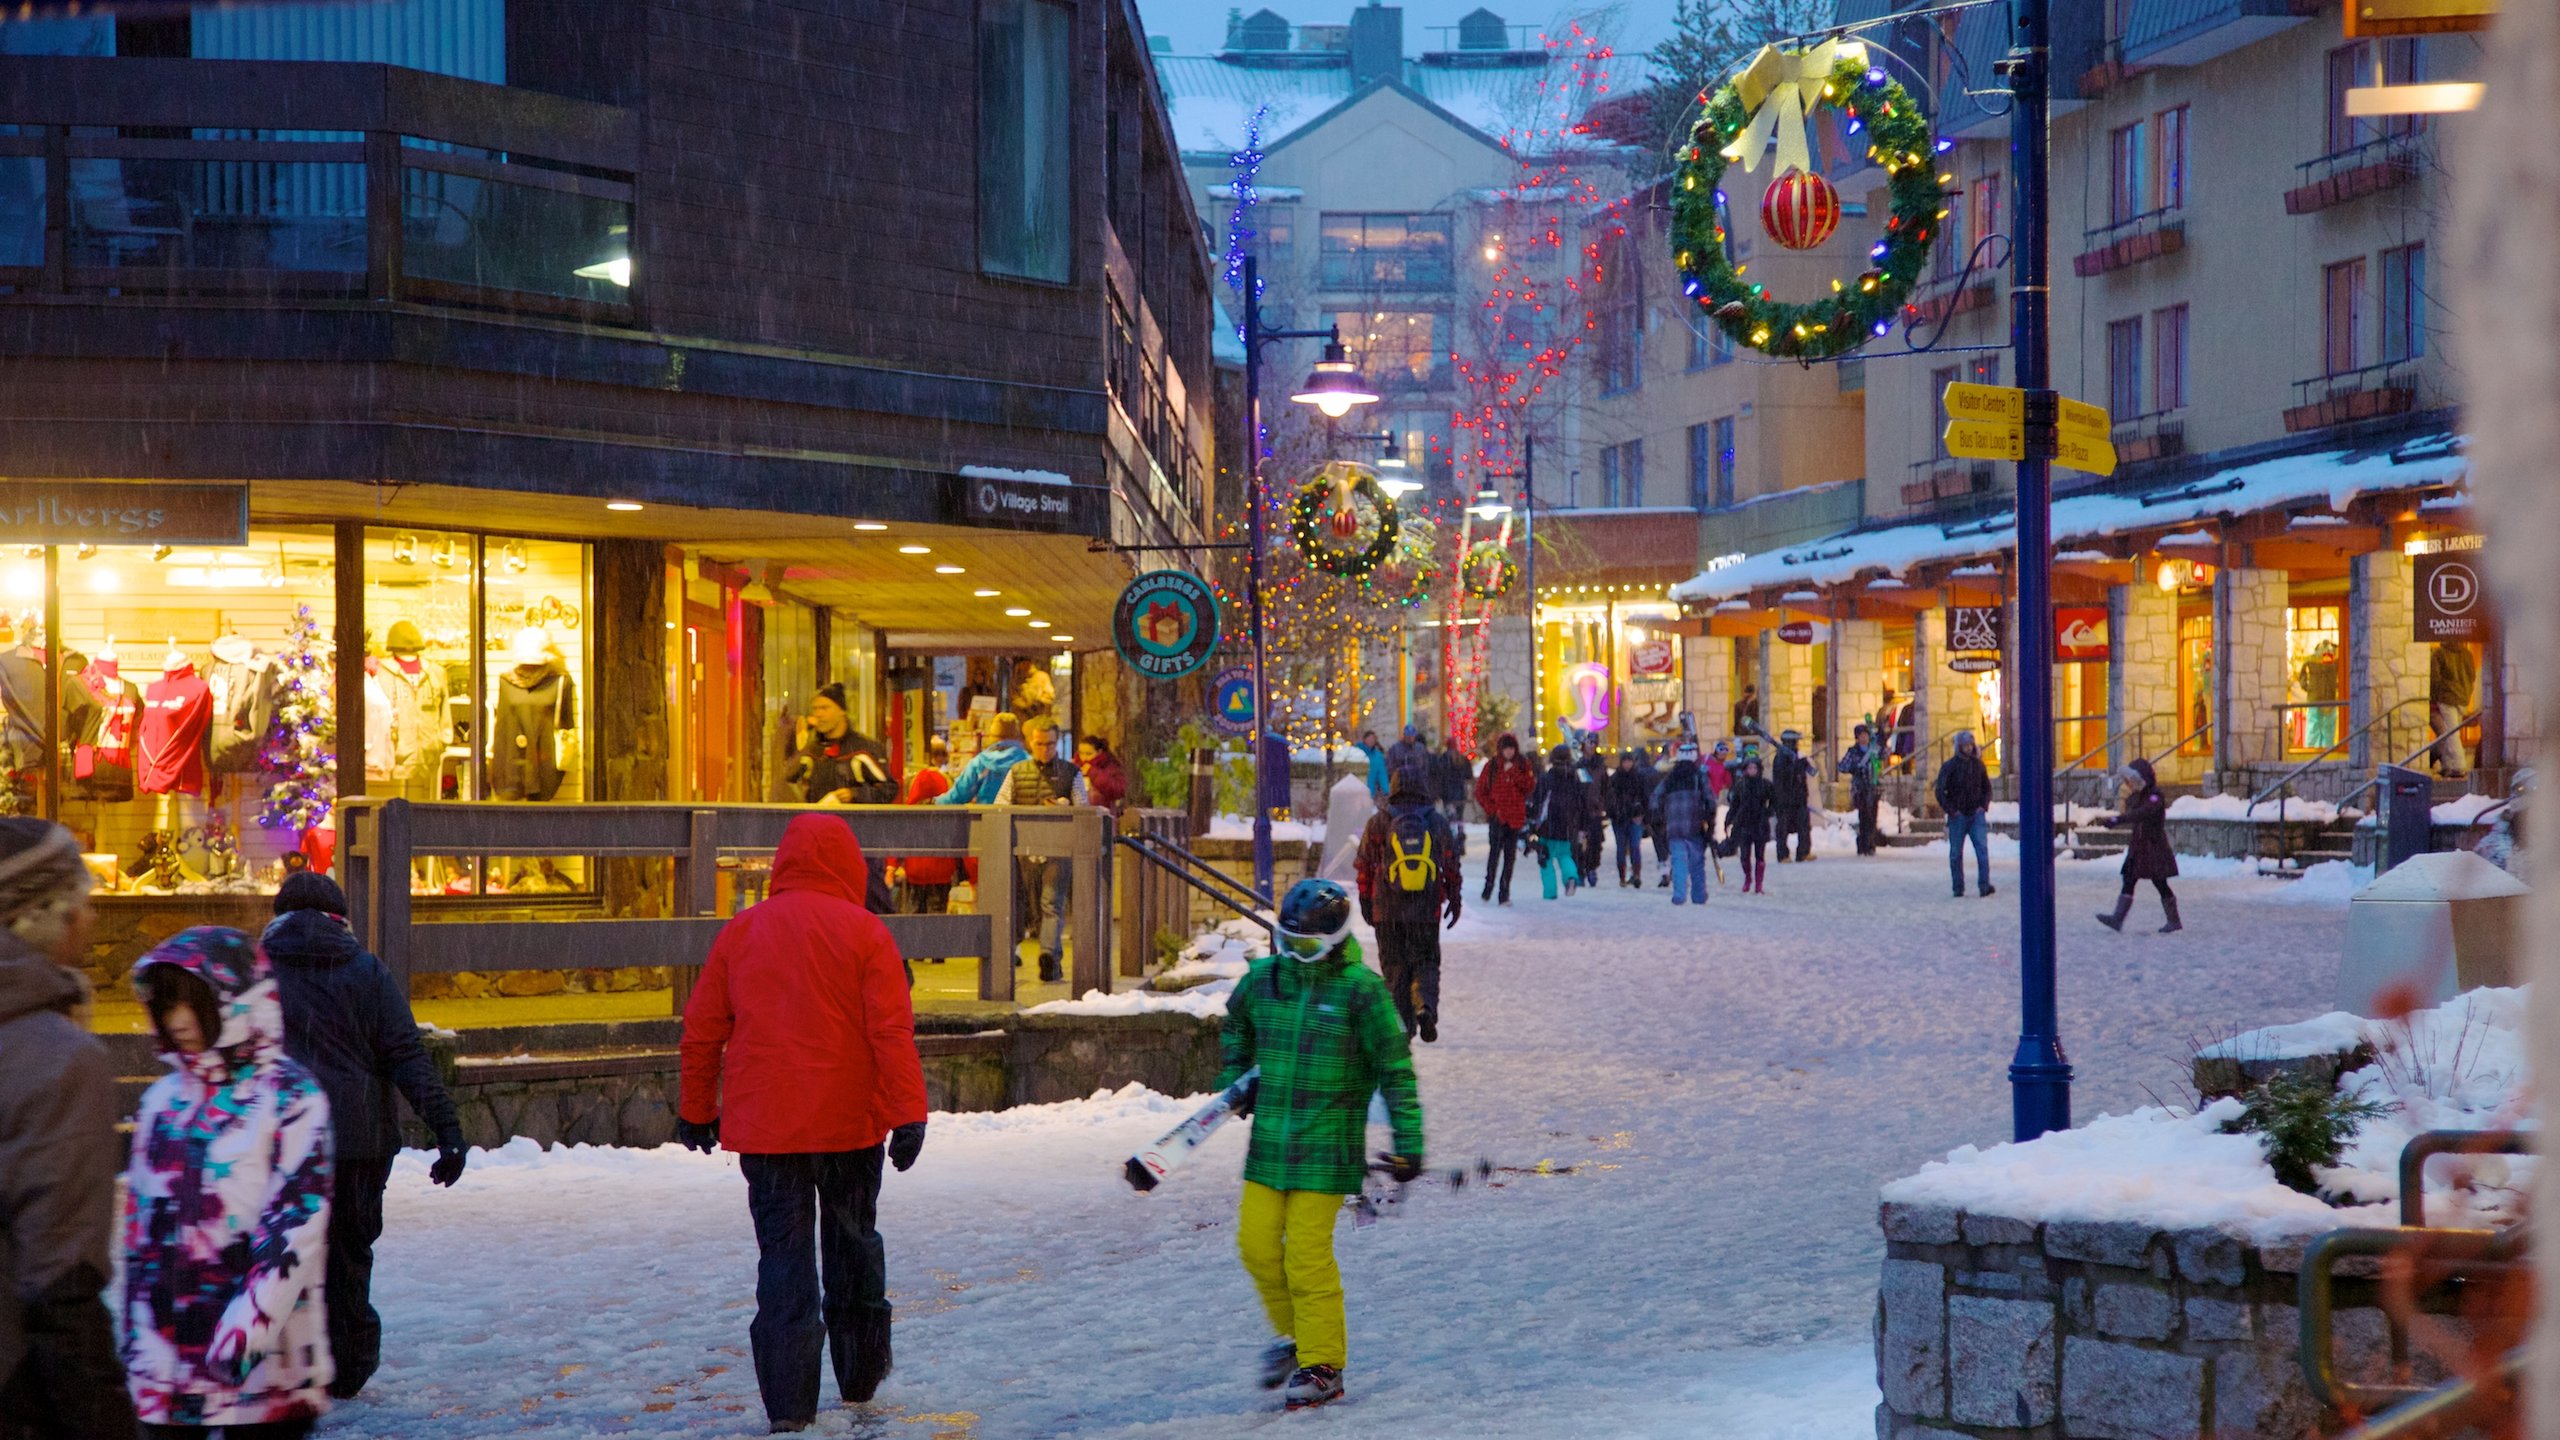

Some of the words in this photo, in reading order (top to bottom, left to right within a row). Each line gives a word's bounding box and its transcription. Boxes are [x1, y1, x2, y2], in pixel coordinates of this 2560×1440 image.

[1958, 391, 1982, 411] Visitor
[1983, 393, 2007, 413] Centre
[1959, 430, 1973, 449] Bus
[1974, 431, 1989, 450] Taxi
[1989, 432, 2007, 452] Loop
[2058, 442, 2069, 458] ers
[2071, 442, 2089, 462] Plaza
[1000, 490, 1038, 514] Village
[1040, 493, 1069, 513] Stroll
[2445, 535, 2485, 552] LEATHE
[2429, 619, 2477, 629] DANIER
[1139, 651, 1195, 673] GIFTS
[904, 694, 914, 763] OPE
